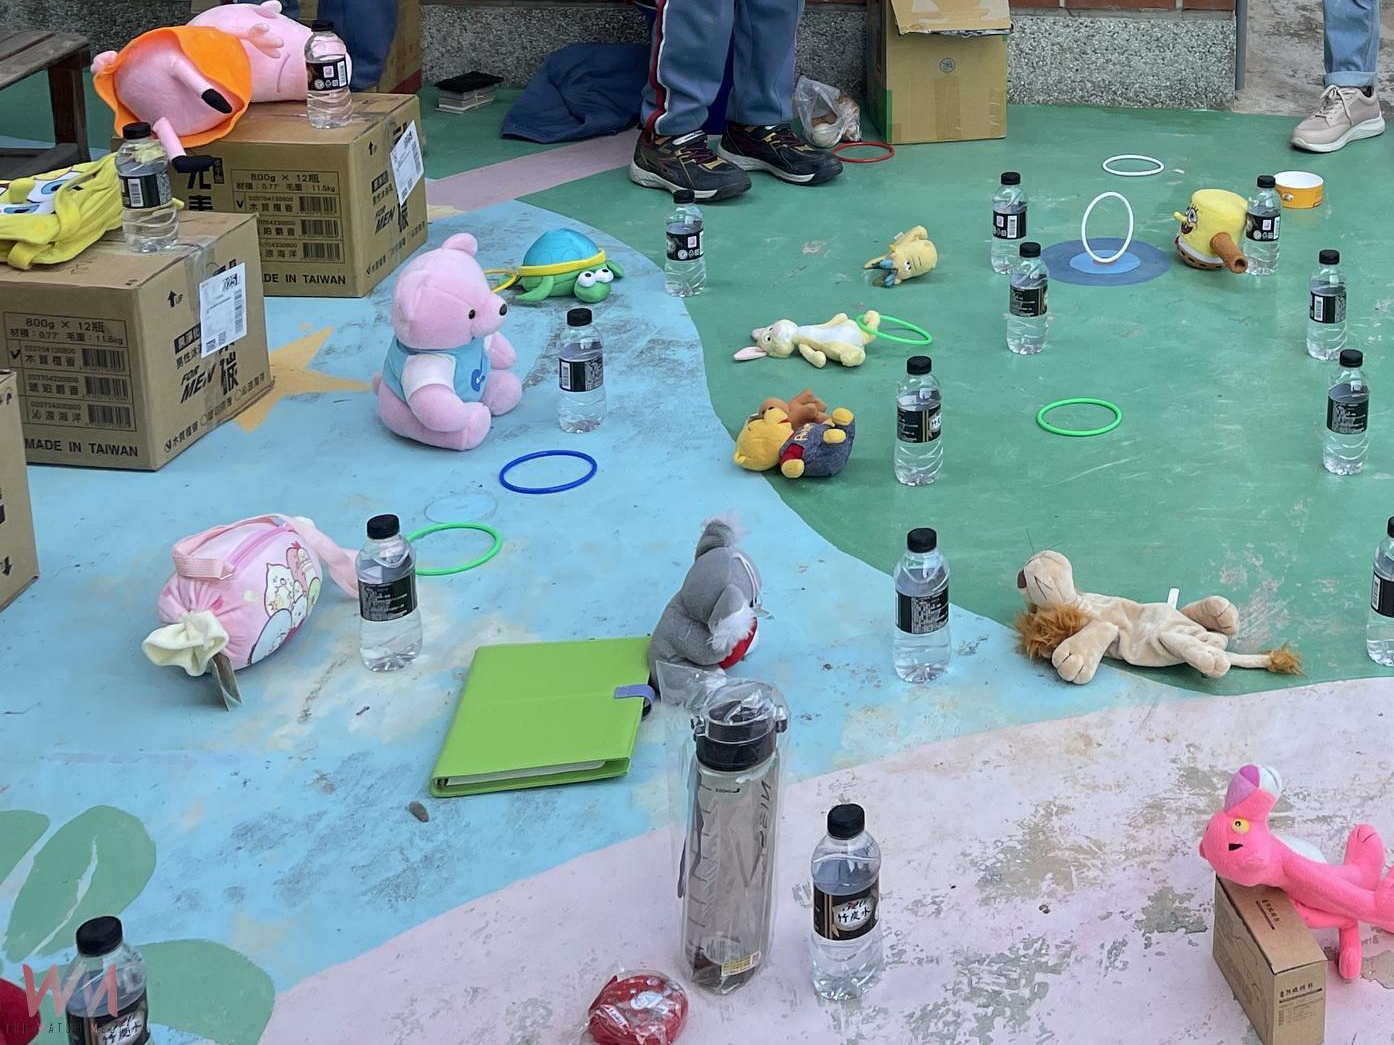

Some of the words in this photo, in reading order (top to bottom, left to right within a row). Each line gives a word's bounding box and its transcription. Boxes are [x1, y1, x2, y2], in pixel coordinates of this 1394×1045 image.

[285, 274, 297, 283] IN
[302, 274, 347, 285] TAIWAN
[180, 364, 200, 387] FOR
[180, 362, 217, 404] MEN
[24, 438, 62, 451] MADE
[69, 441, 82, 452] IN
[88, 443, 138, 457] TAIWAN
